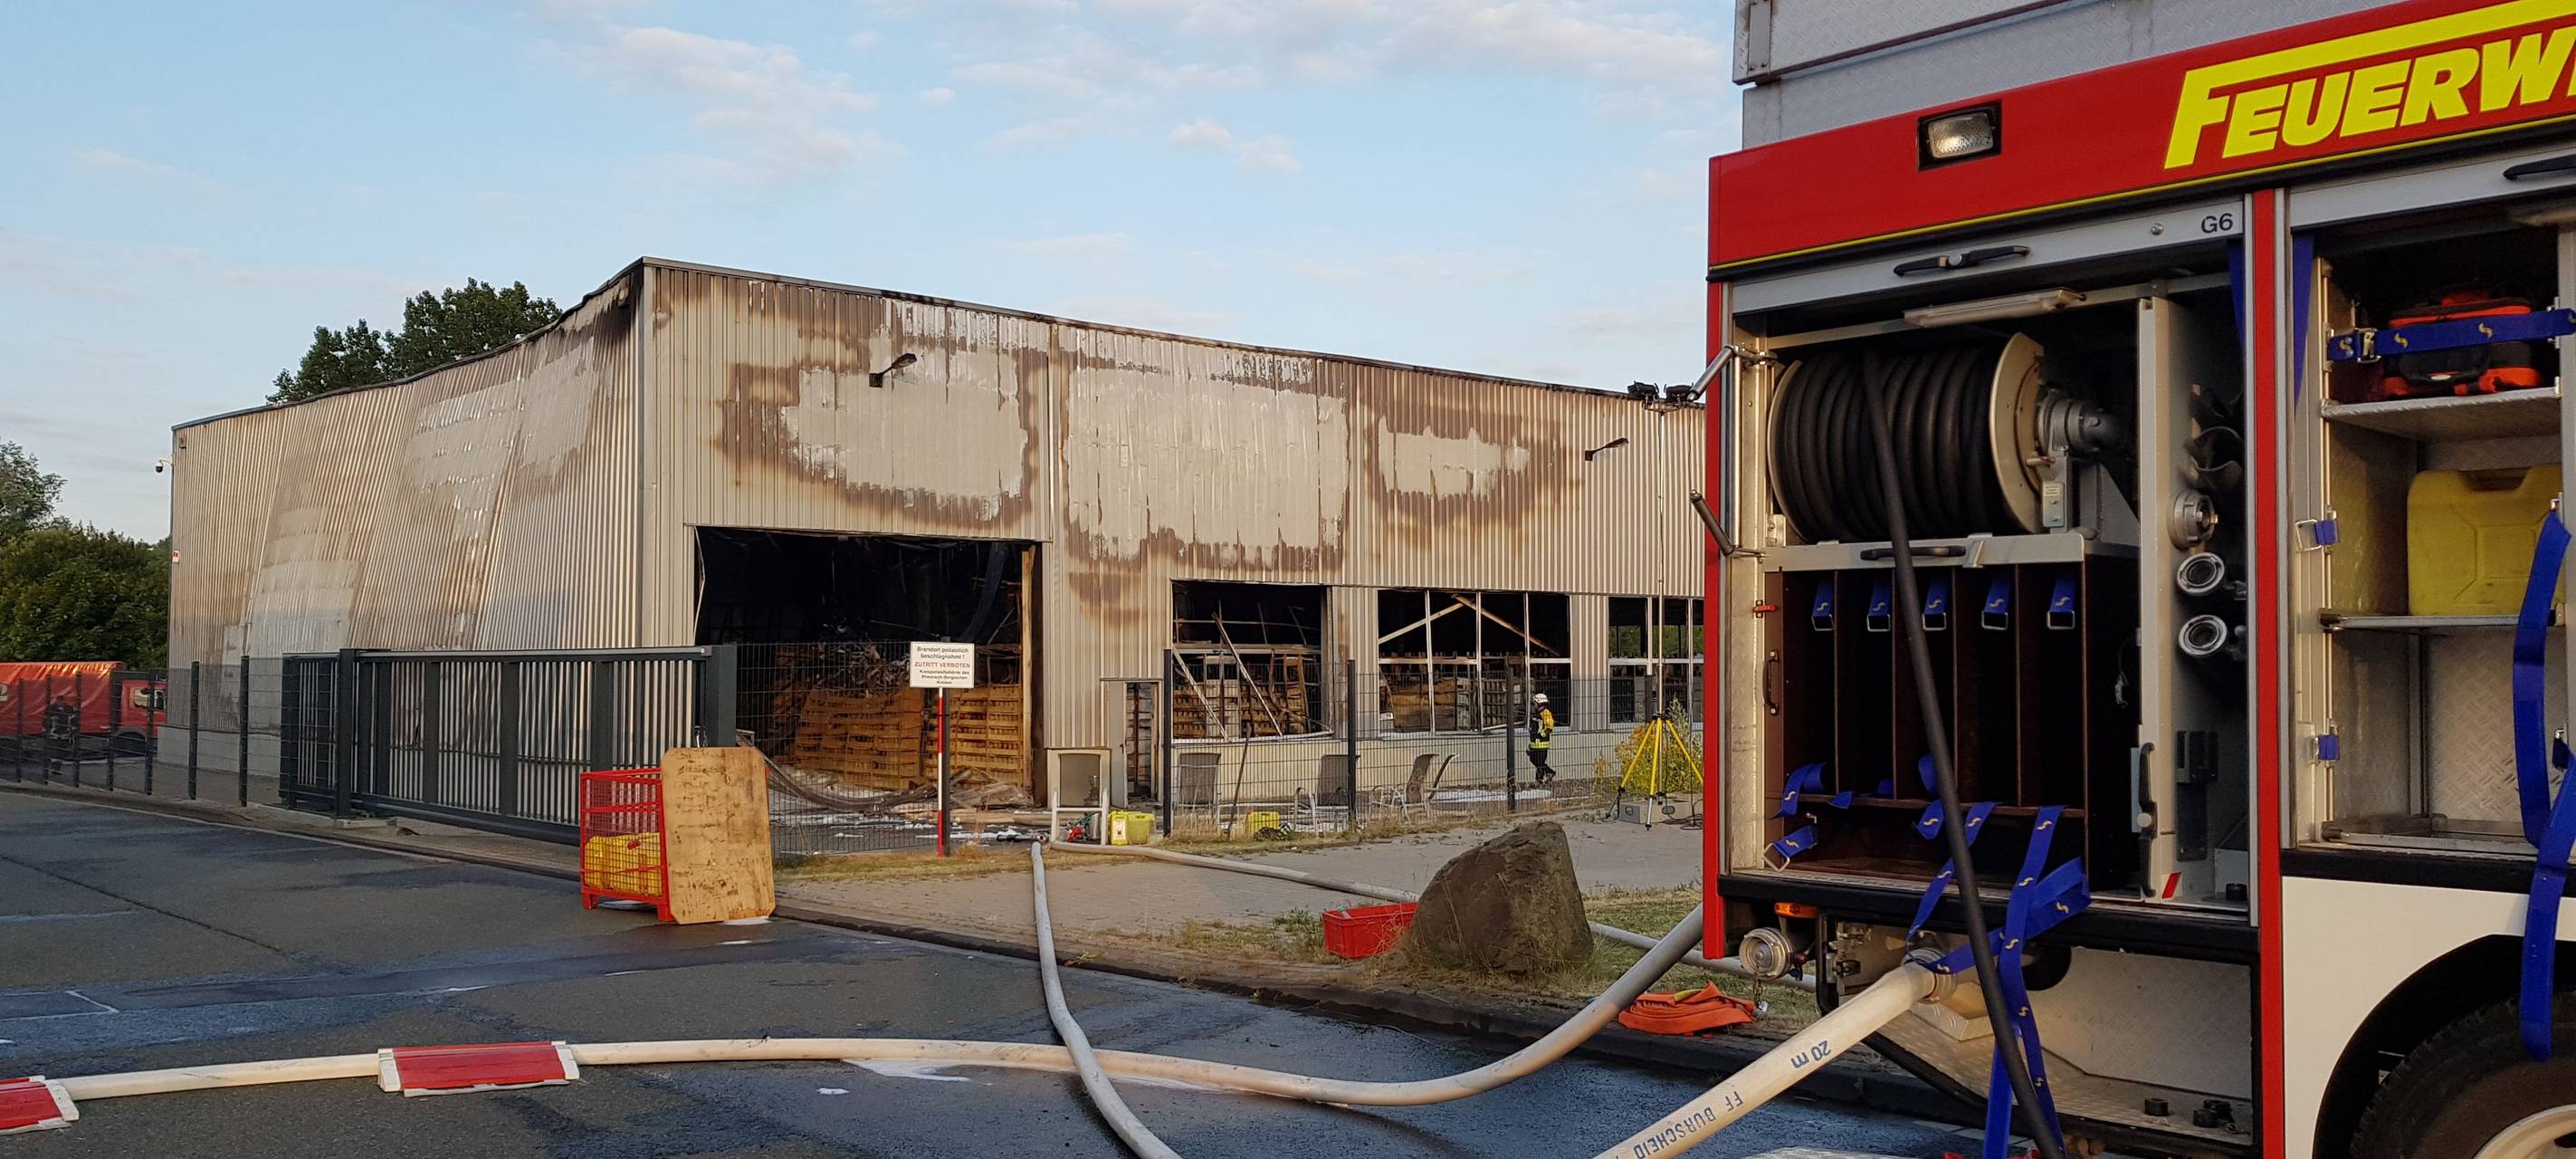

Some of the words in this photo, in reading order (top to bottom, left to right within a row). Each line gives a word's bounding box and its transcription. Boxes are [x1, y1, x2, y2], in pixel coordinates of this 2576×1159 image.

[2164, 0, 2576, 170] FEUERW
[2200, 213, 2234, 234] G6
[1811, 1040, 1831, 1061] 20
[1790, 1057, 1809, 1068] m
[1725, 1091, 1744, 1112] FF
[1633, 1106, 1717, 1159] BURSCHEID
